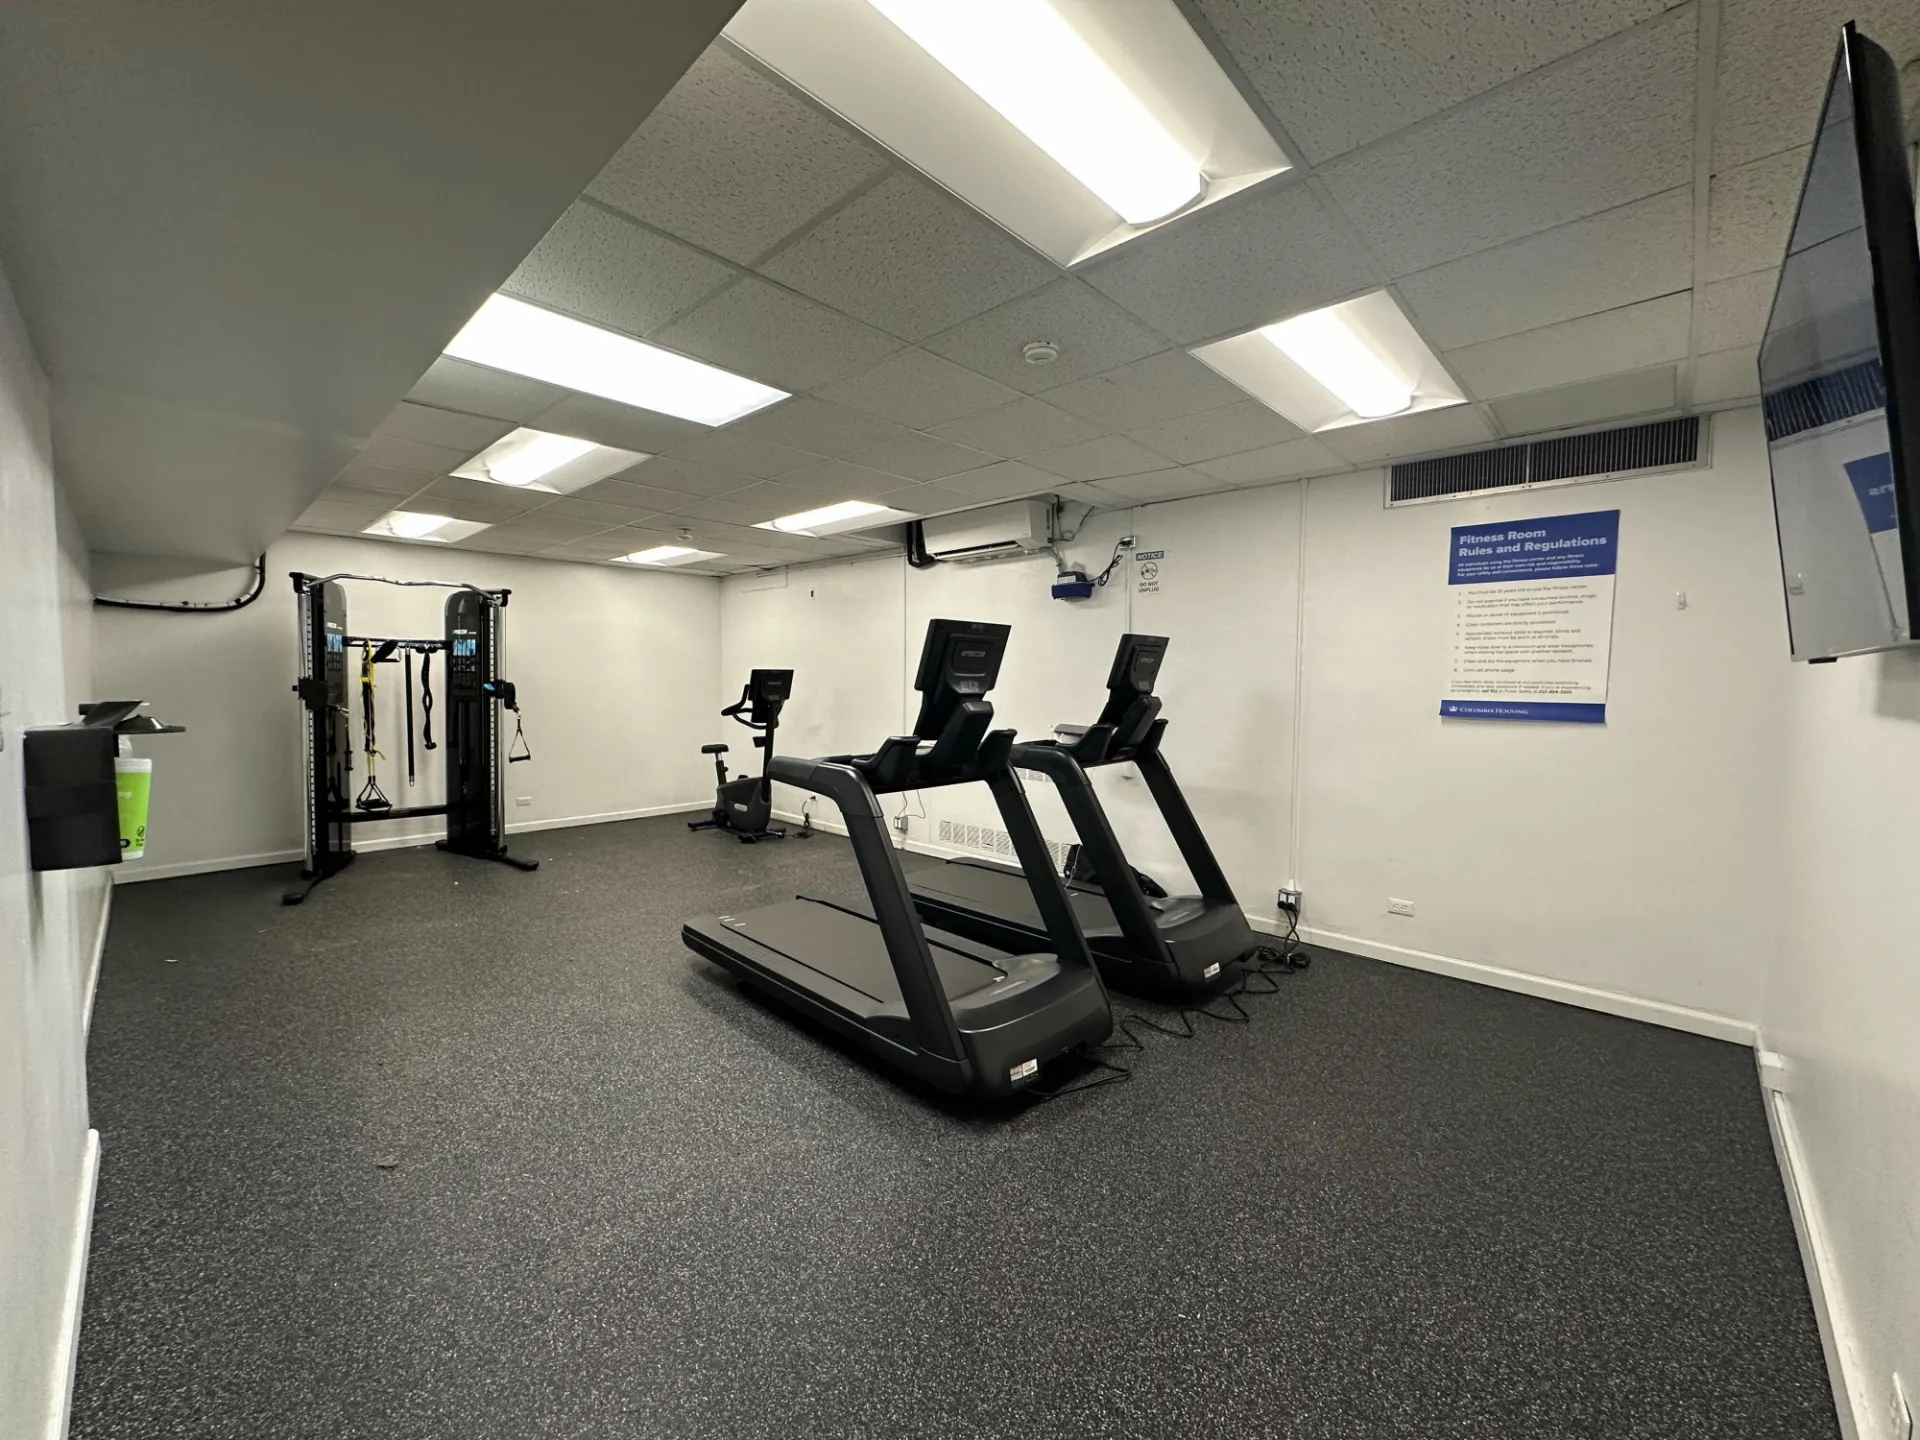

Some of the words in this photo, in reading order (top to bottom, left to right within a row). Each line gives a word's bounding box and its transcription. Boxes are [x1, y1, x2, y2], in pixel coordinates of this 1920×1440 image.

[1460, 533, 1504, 545] Fitness
[1507, 530, 1546, 540] Room
[1459, 546, 1493, 557] Rules
[1496, 542, 1521, 554] and
[1524, 536, 1607, 552] Regulations
[1136, 551, 1163, 560] NOTICE
